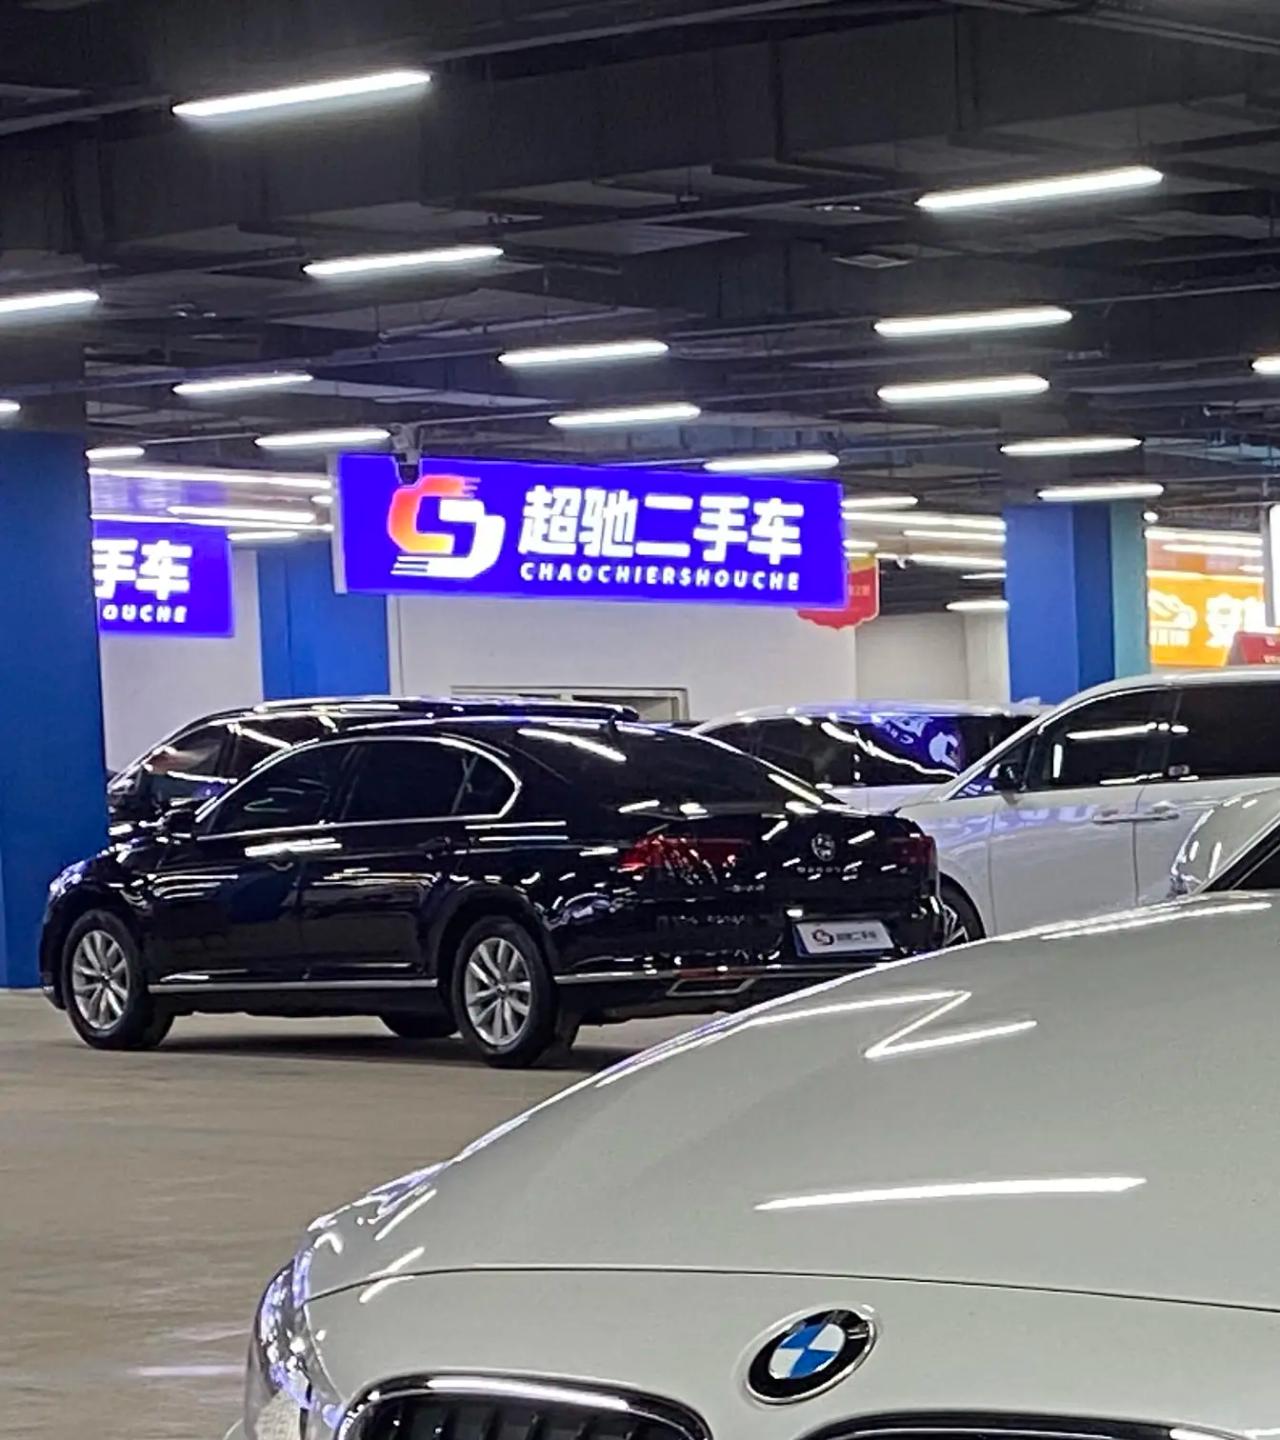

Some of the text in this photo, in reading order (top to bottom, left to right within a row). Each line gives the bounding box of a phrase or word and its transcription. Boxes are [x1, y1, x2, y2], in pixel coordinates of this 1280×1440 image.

[518, 485, 804, 565] 超驰二手车
[520, 562, 799, 591] CHAOCHIERSHOUCHE
